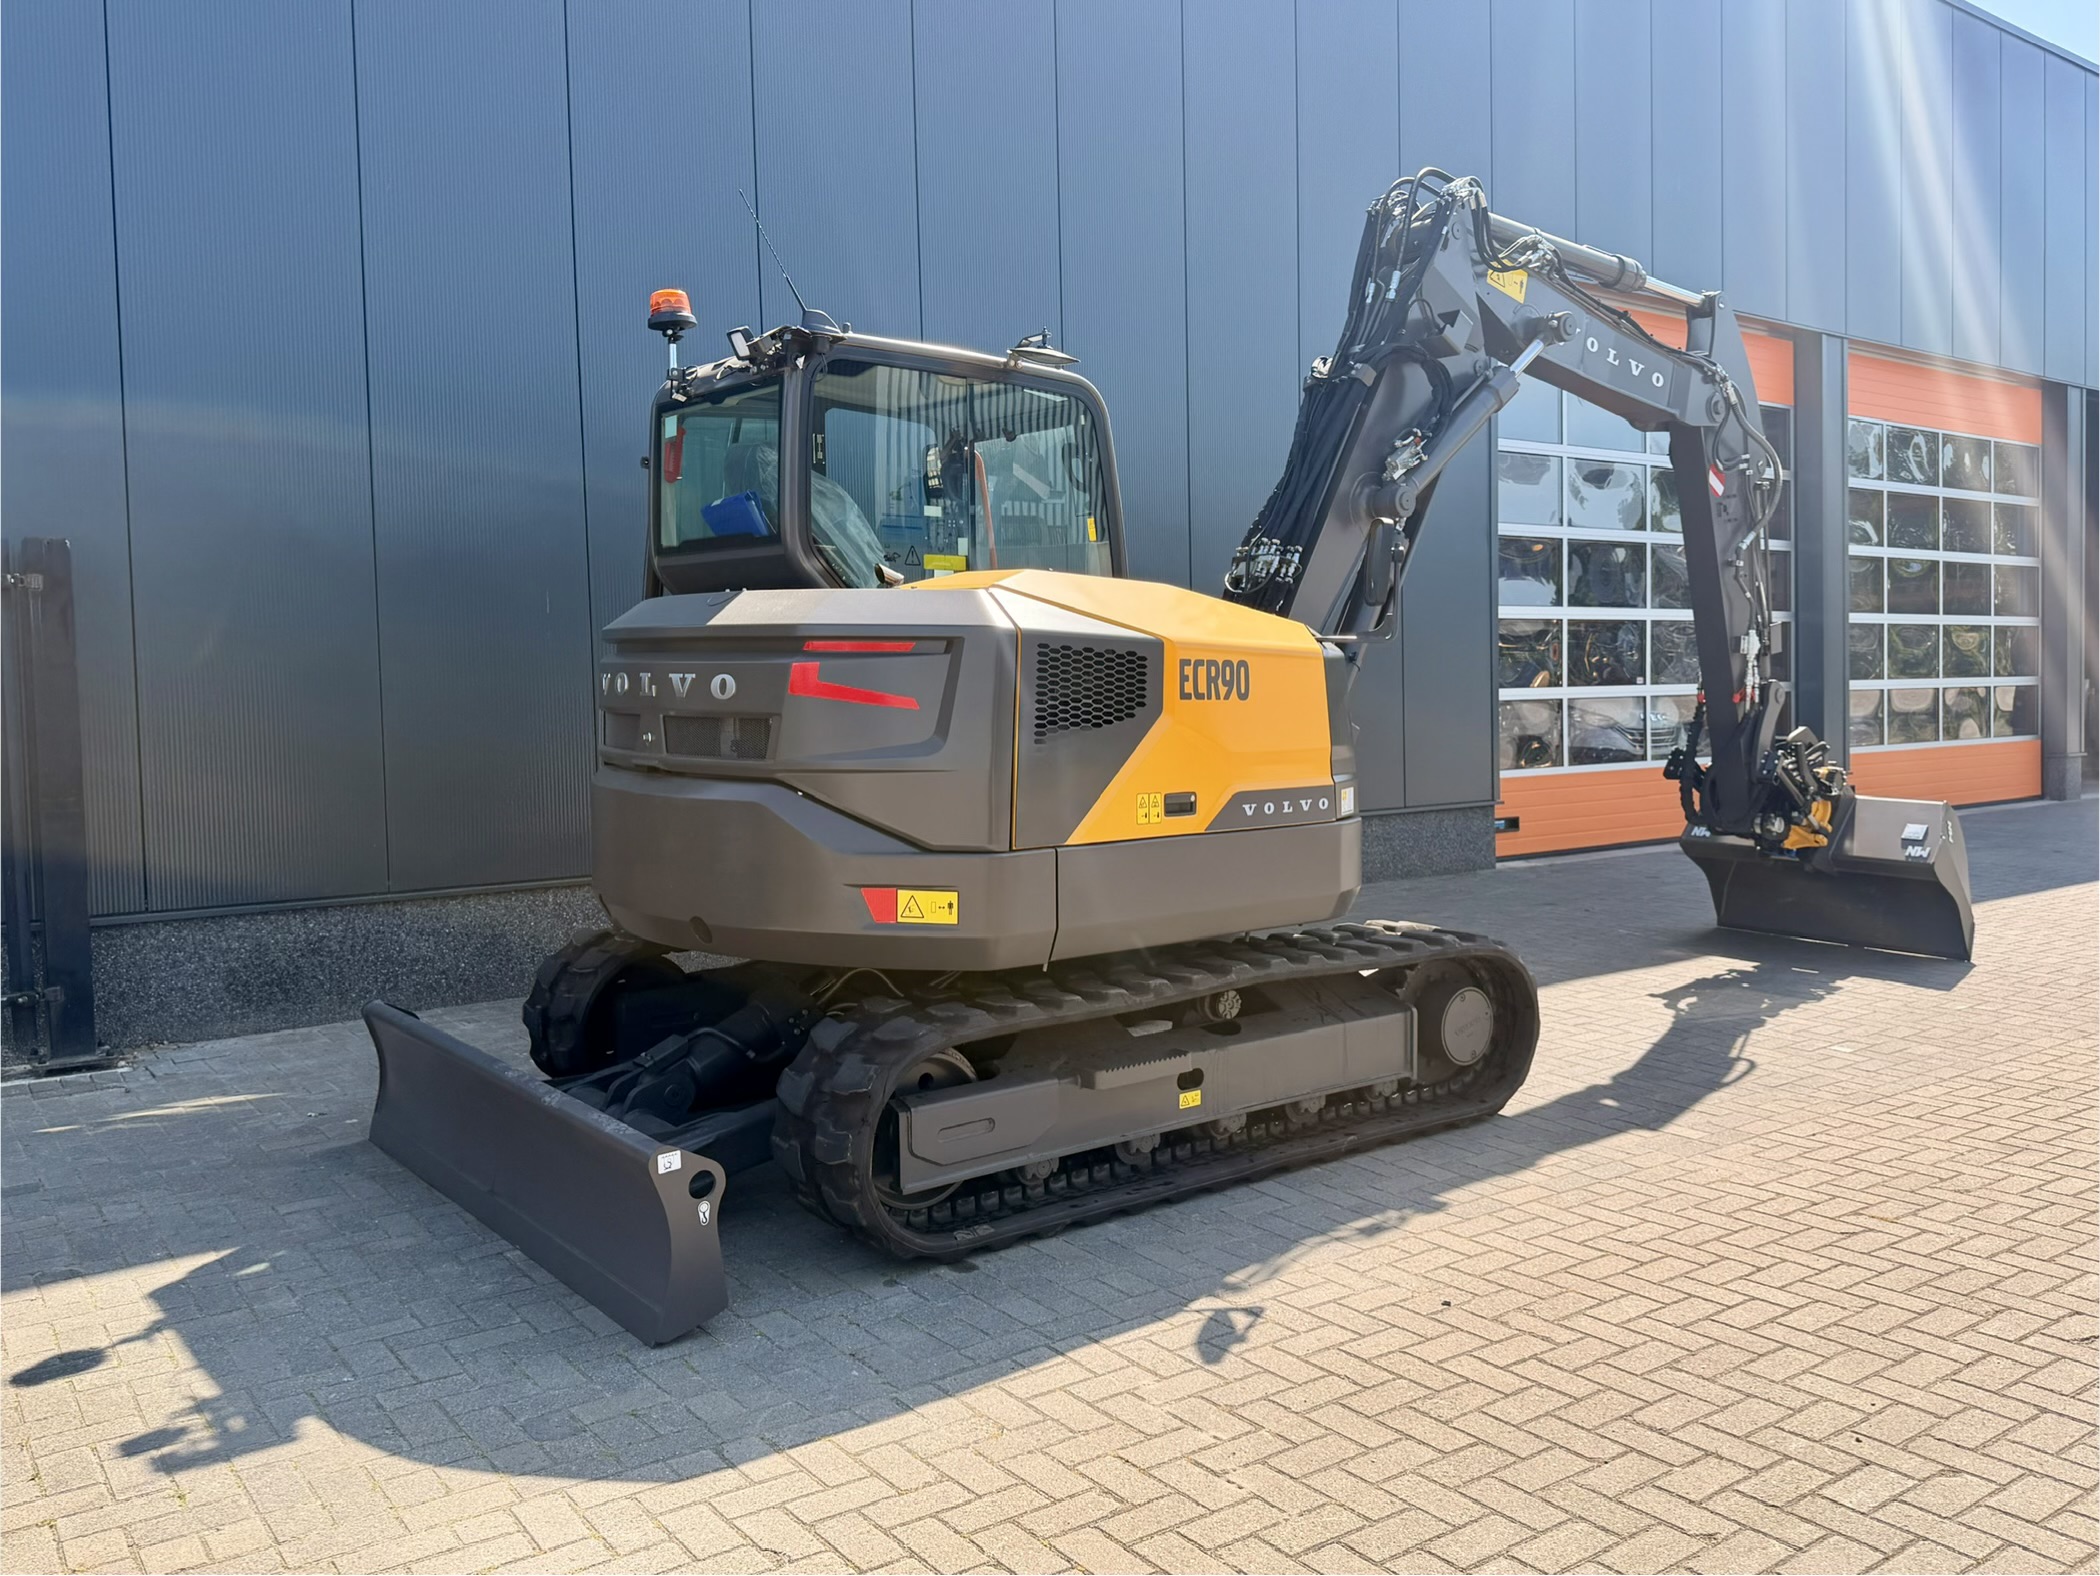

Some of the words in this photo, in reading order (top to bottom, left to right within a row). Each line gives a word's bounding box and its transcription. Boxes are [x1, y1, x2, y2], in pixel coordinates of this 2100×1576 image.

[1568, 328, 1664, 387] OLVO
[601, 672, 736, 700] VOLVO
[1179, 658, 1250, 701] ECR90
[1242, 797, 1329, 816] VOLVO
